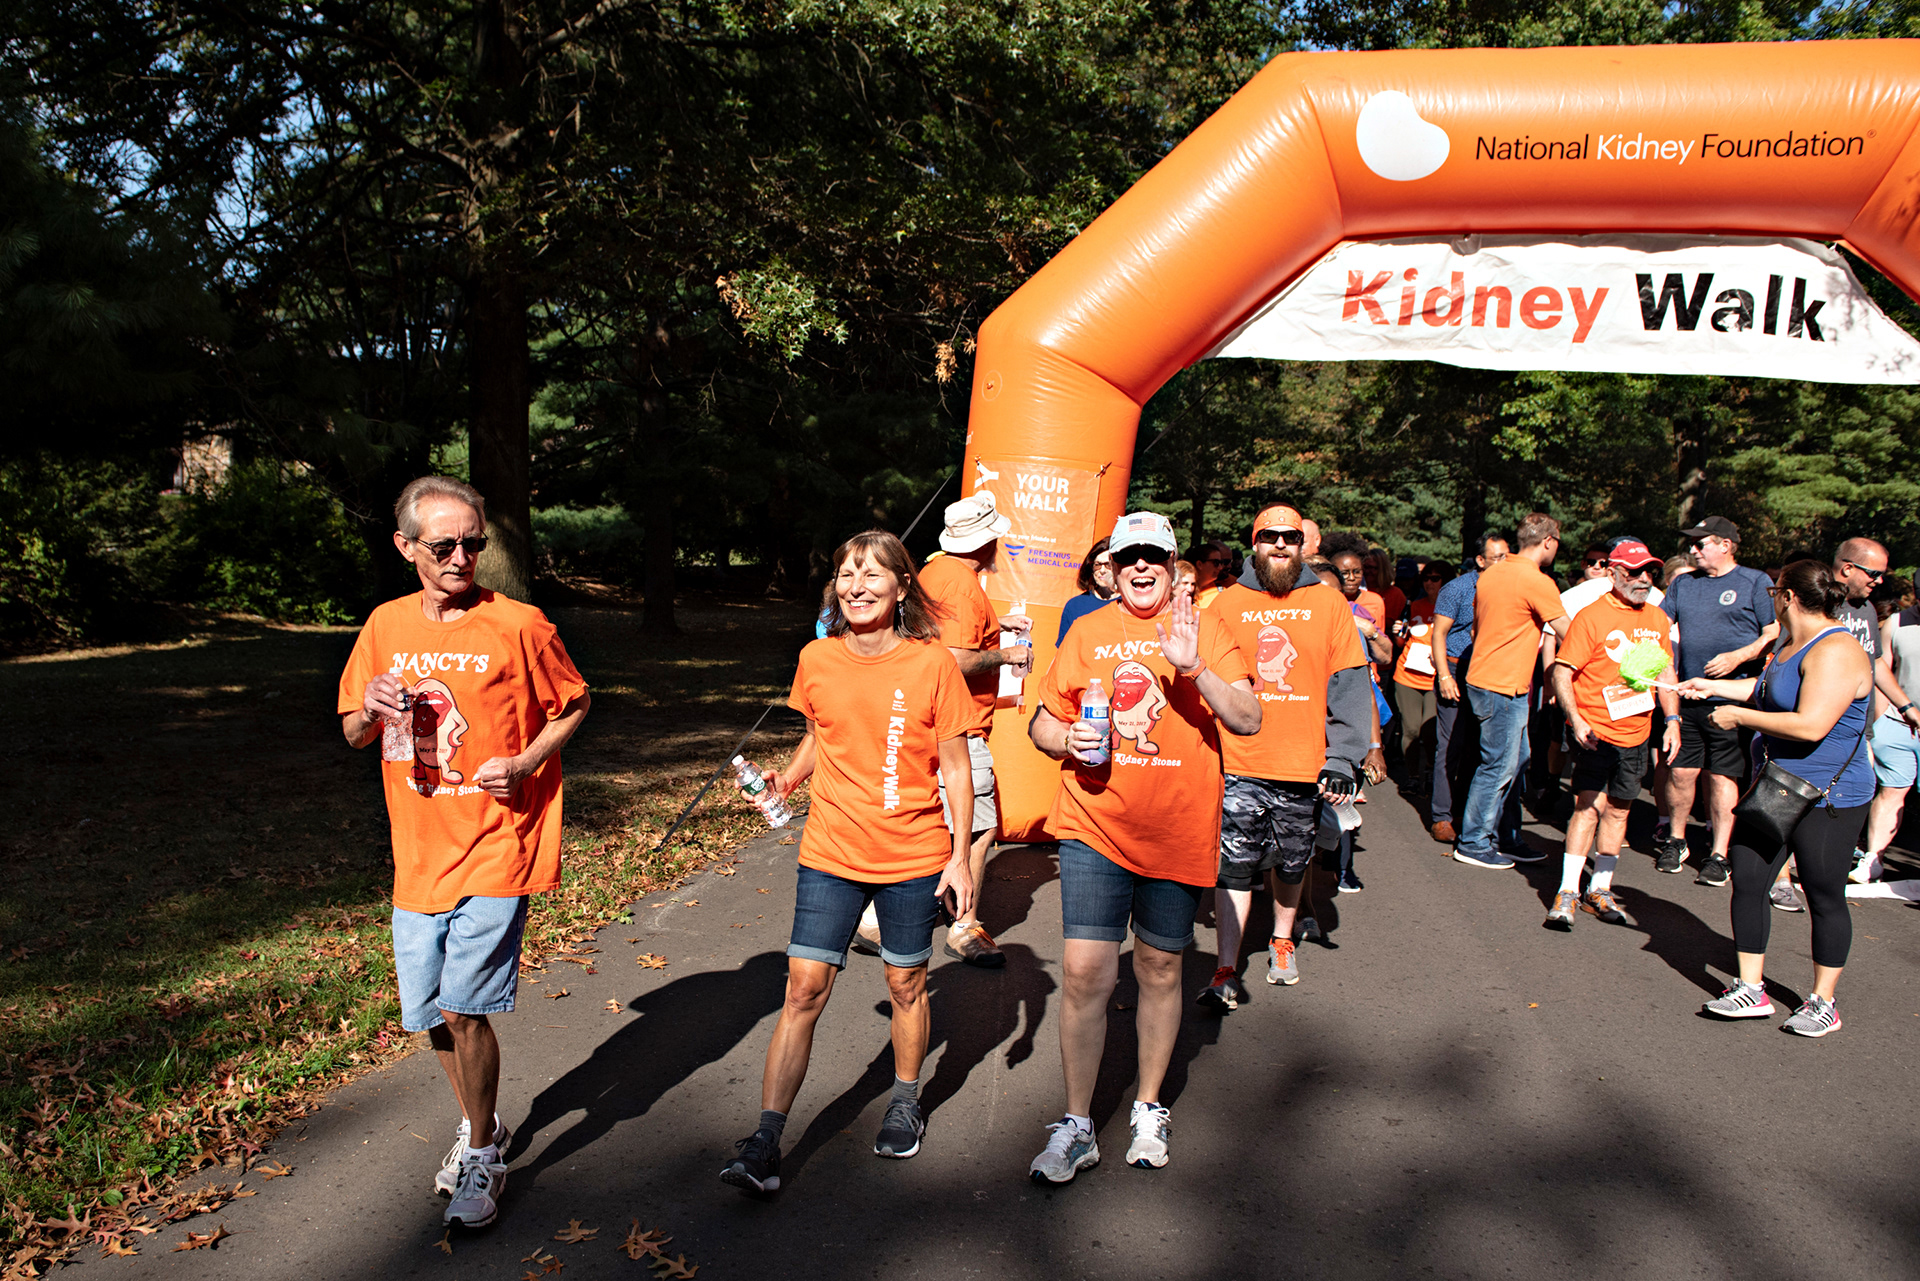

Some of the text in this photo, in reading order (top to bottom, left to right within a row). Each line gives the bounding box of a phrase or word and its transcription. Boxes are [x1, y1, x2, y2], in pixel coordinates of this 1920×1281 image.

[1475, 133, 1589, 160] National
[1596, 132, 1695, 165] Kidney
[1341, 267, 1827, 344] Kidney Walk
[1015, 473, 1070, 495] YOUR
[1013, 491, 1070, 513] WALK
[1027, 557, 1061, 567] MEDICAL
[1028, 549, 1071, 560] FRESENIUS
[1241, 608, 1312, 626] NANCY'S
[1837, 612, 1871, 641] idney
[1633, 628, 1662, 639] Kidney
[392, 652, 490, 678] NANCY'S
[1260, 692, 1287, 702] Kidney
[1287, 693, 1310, 701] Stones
[1114, 752, 1182, 767] Kidney Stones
